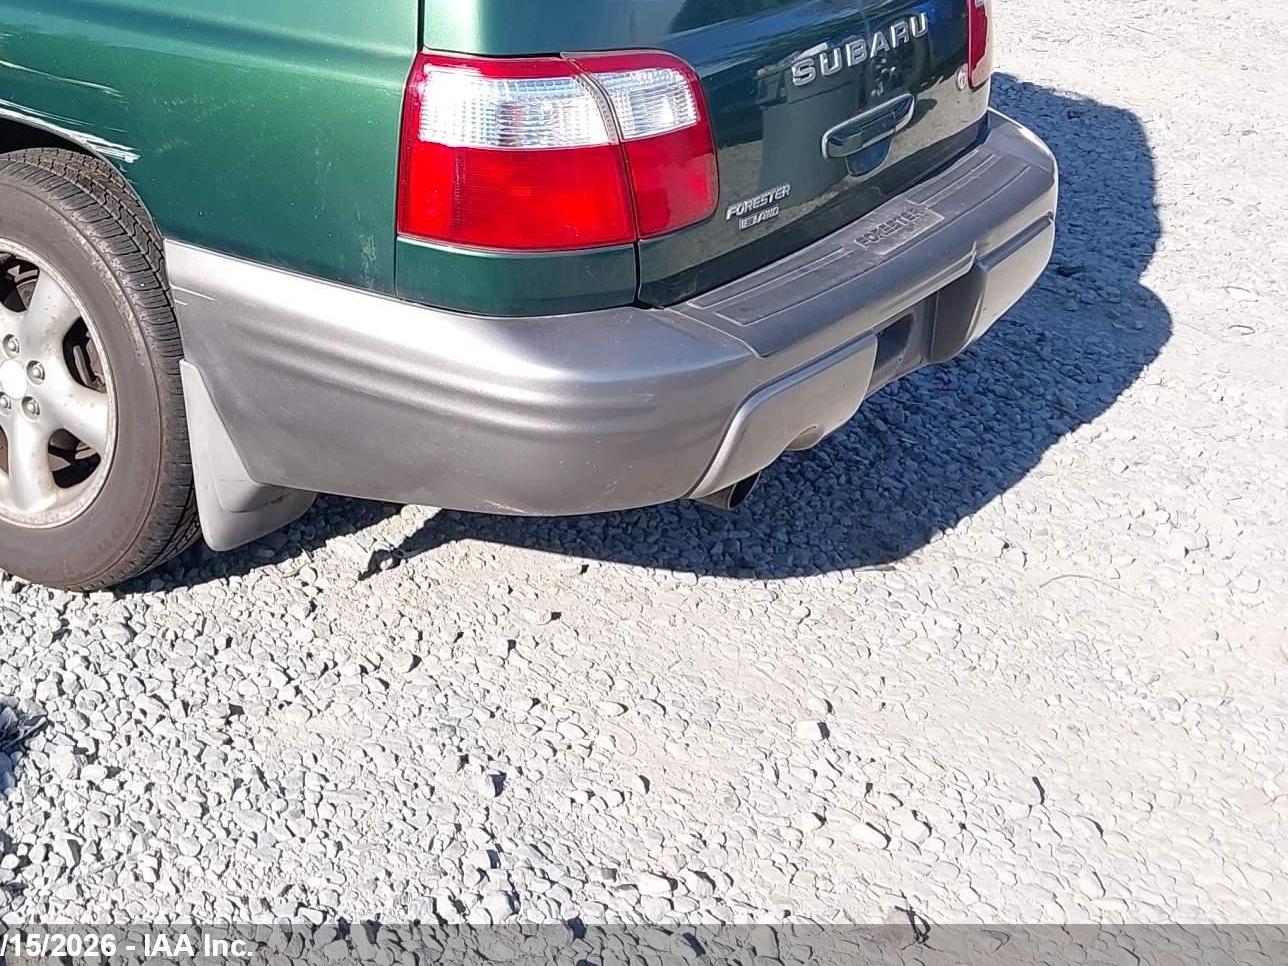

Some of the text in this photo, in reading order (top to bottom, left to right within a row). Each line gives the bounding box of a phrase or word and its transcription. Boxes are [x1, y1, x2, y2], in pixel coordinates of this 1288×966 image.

[791, 12, 929, 87] SUBARU
[725, 183, 792, 222] FORESTER
[854, 207, 927, 249] FORESTER
